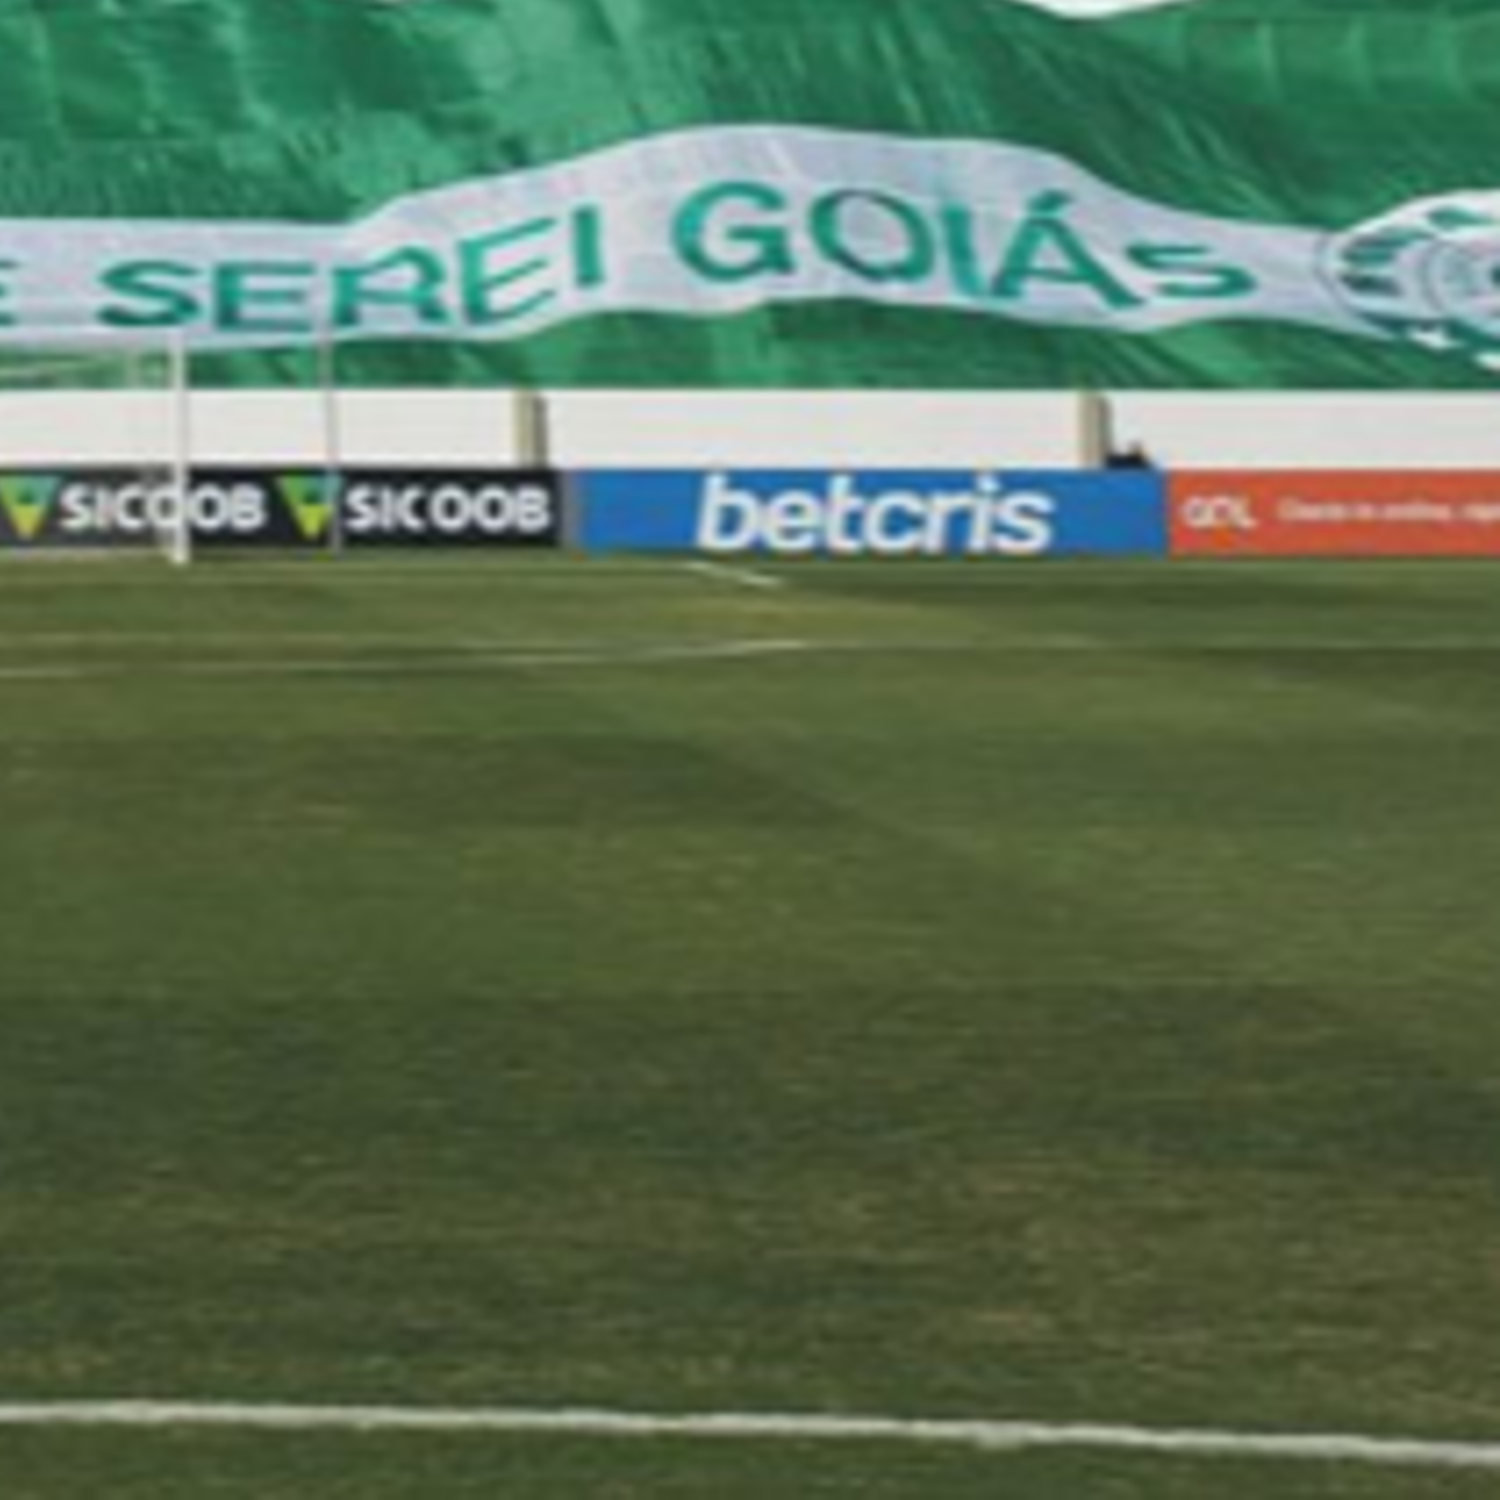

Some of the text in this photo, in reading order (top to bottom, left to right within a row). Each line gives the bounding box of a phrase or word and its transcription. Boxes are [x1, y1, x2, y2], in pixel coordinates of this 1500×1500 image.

[96, 206, 605, 332] SEREI
[671, 180, 1258, 309] GOIÁS
[59, 483, 266, 532] SICOOB
[344, 483, 552, 532] SICOOB
[695, 471, 1056, 555] betcris
